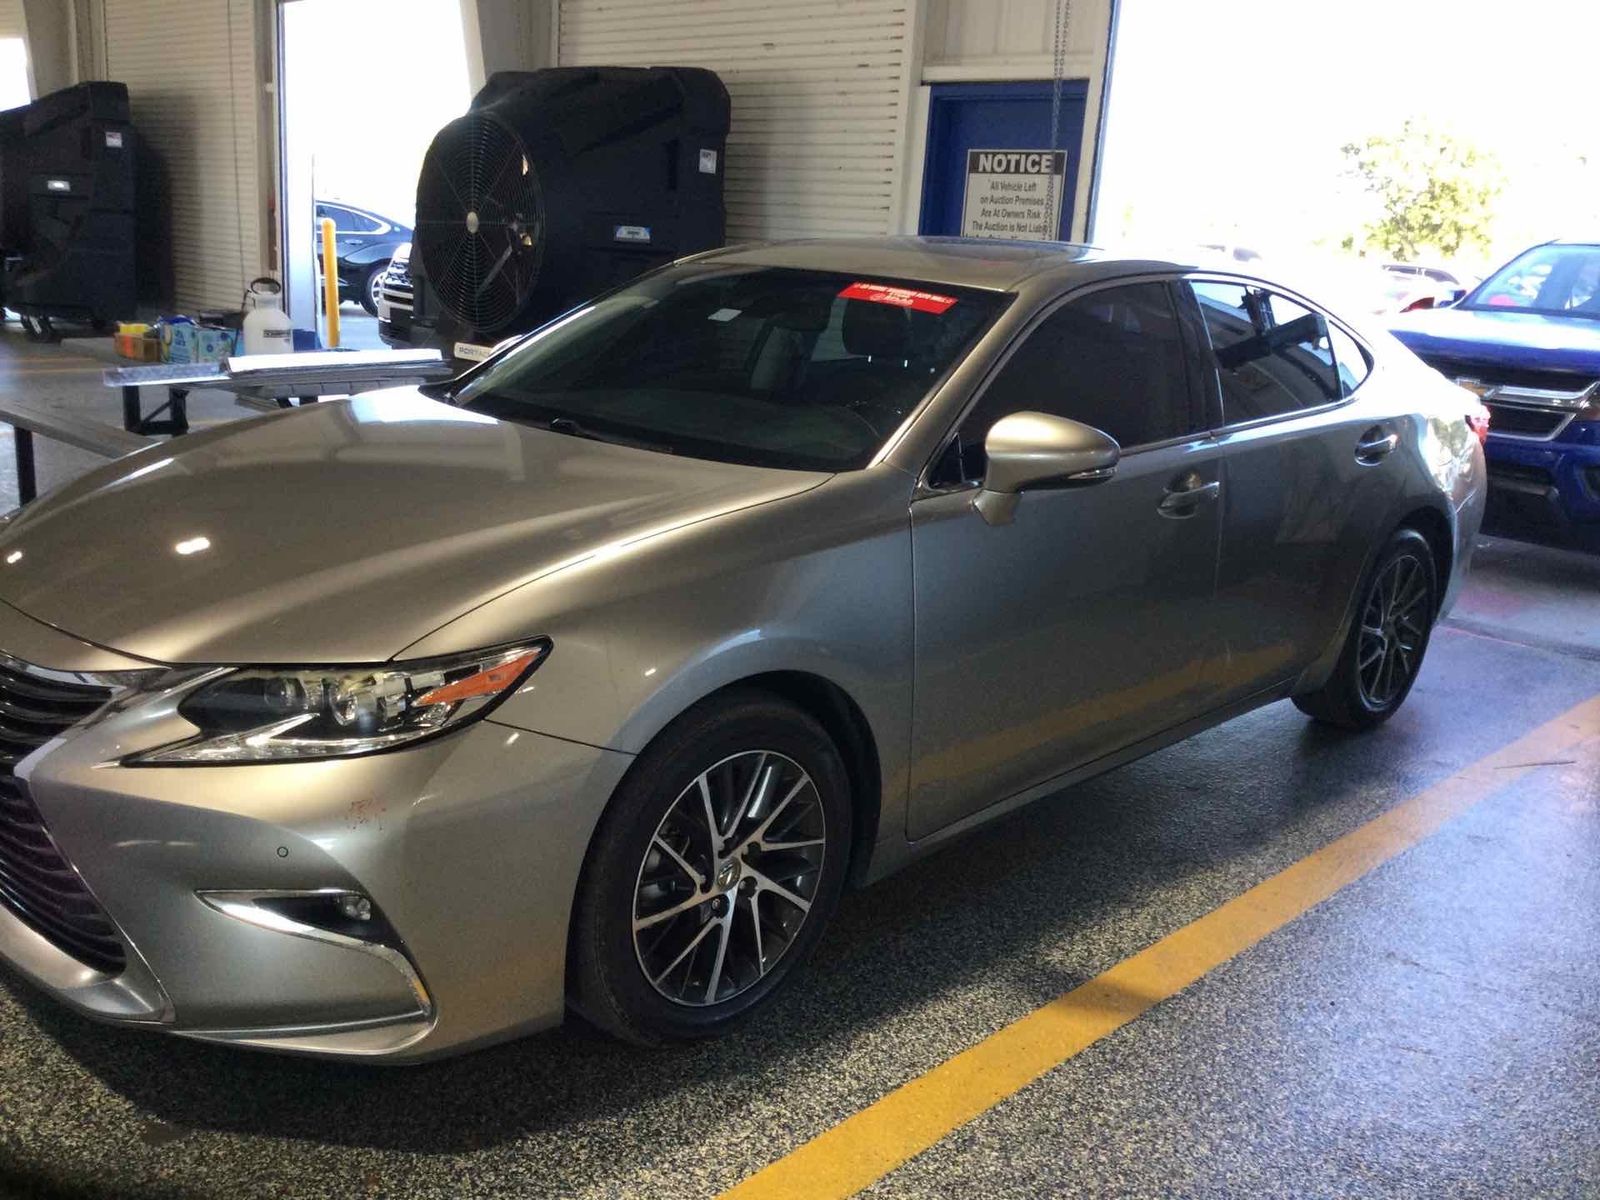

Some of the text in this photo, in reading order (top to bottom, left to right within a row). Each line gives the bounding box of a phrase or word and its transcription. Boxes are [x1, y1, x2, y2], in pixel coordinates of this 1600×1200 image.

[978, 154, 1054, 173] NOTICE
[989, 195, 1013, 205] Auction
[984, 221, 1008, 232] Auction
